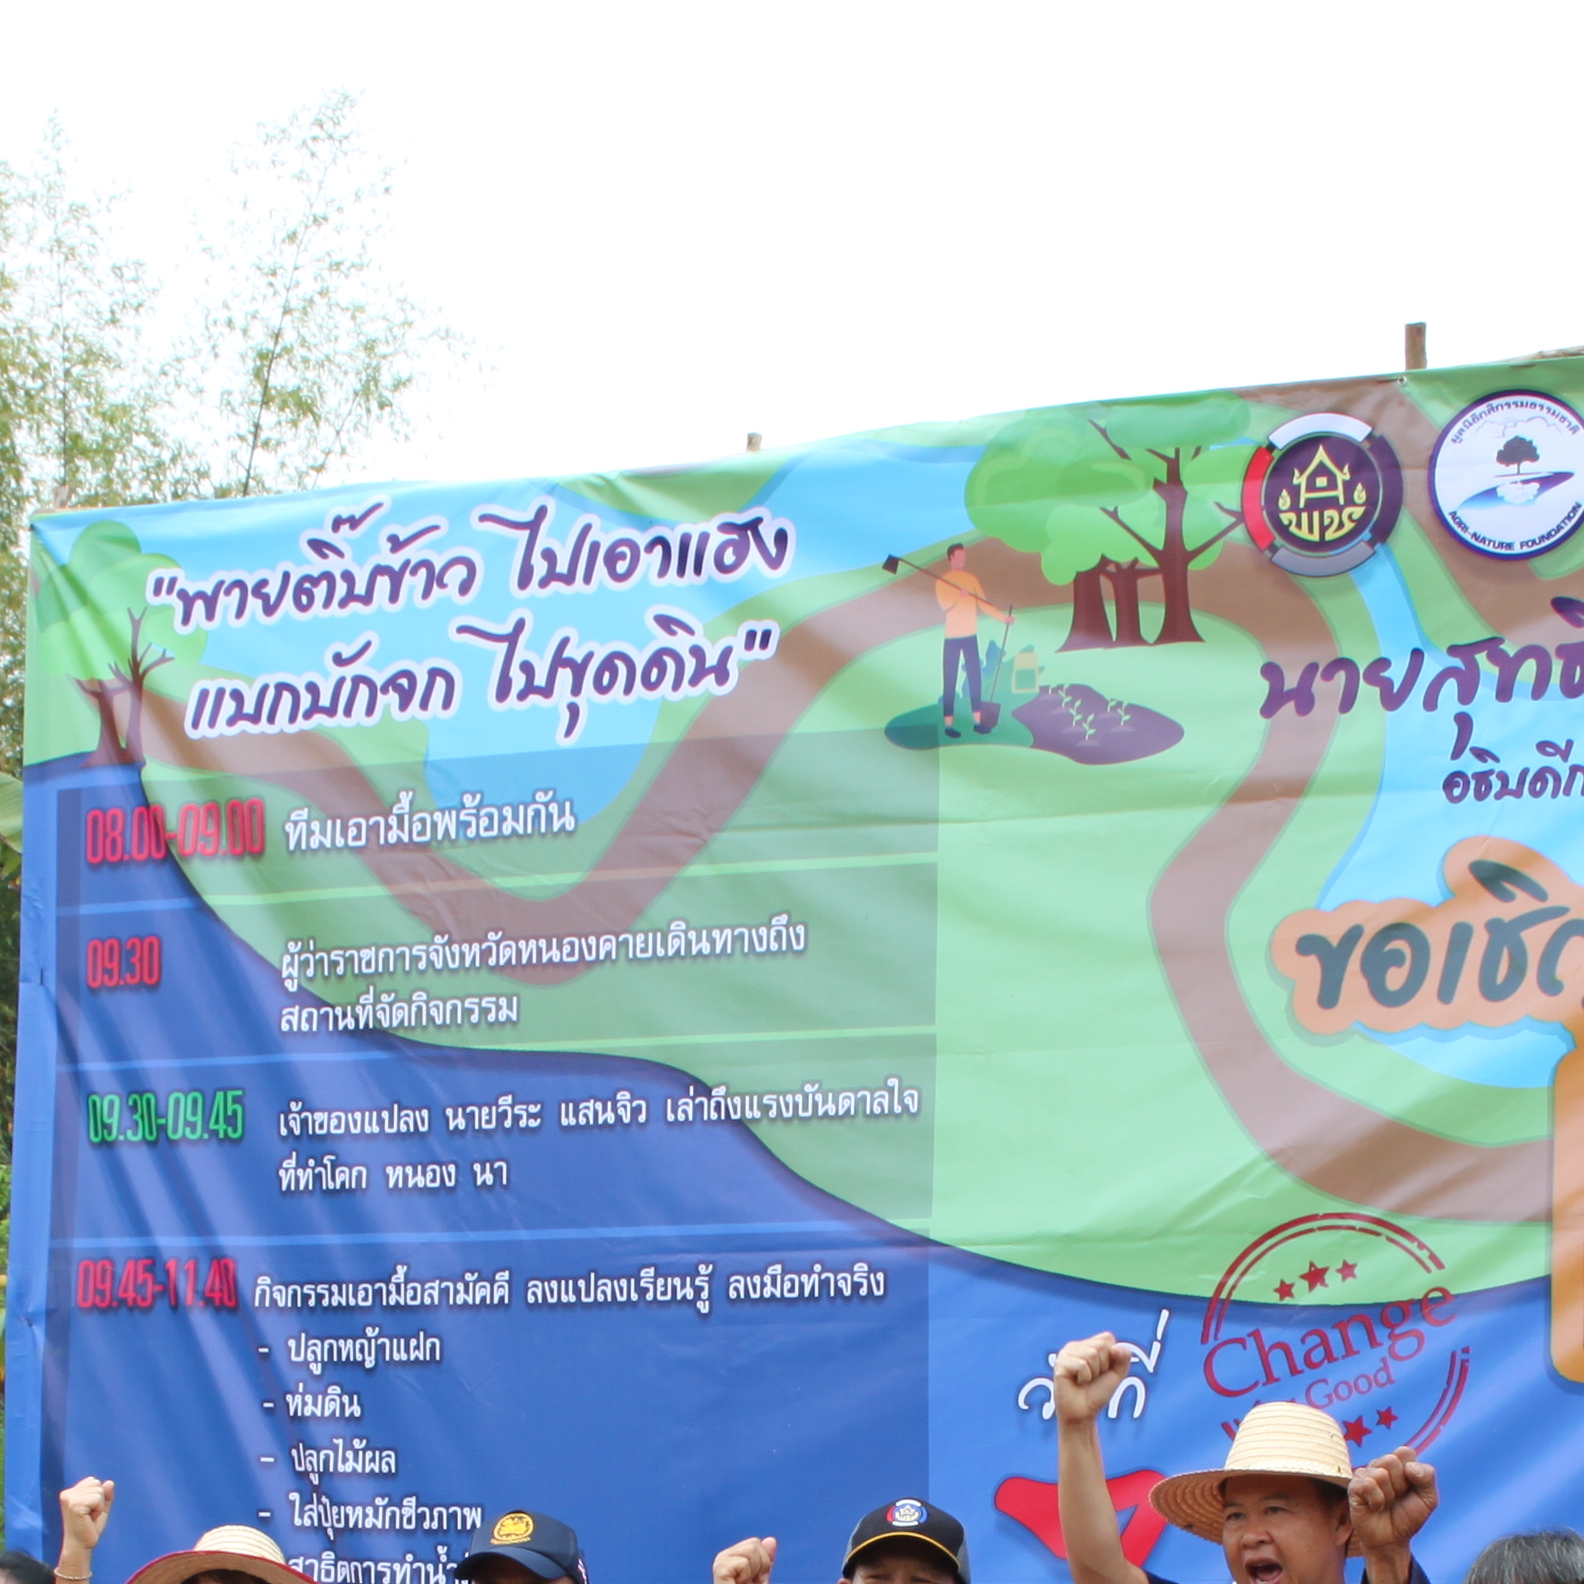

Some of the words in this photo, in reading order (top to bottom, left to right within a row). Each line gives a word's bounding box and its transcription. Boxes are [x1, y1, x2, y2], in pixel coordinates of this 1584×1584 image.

[1448, 510, 1515, 551] AGRI-NATURE
[1519, 501, 1583, 550] FOUNDATION
[85, 796, 266, 865] 08.00-09.00
[284, 790, 576, 851] ทีมเอามื้อพร้อมกัน
[86, 936, 162, 989] 09.30
[281, 914, 806, 992] ผู้ว่าราชการจังหวัดหนองคายเดินทางถึง
[280, 985, 519, 1033] สถานที่จัดกิจกรรม
[88, 1089, 245, 1144] 09.30-09.45
[279, 1100, 429, 1137] เจ้าของแปลง
[445, 1094, 541, 1131] นายวีระ
[560, 1090, 647, 1127] แสนจิว
[665, 1077, 919, 1122] เล่าถึงแรงบันดาลใจ
[278, 1150, 367, 1192] ที่ทำโคก
[386, 1159, 457, 1188] หนอง
[472, 1159, 508, 1187] นา
[254, 1265, 510, 1308] กิจกรรมเอามื้อสามัคคี
[526, 1264, 713, 1315] ลงแปลงเรียนรู้
[727, 1261, 886, 1300] ลงมือทำจริง
[287, 1326, 441, 1375] ปลูกหญ้าแฝก
[1203, 1285, 1457, 1397] Change
[1304, 1357, 1396, 1411] Good
[290, 1437, 397, 1486] ปลูกไม้ผล
